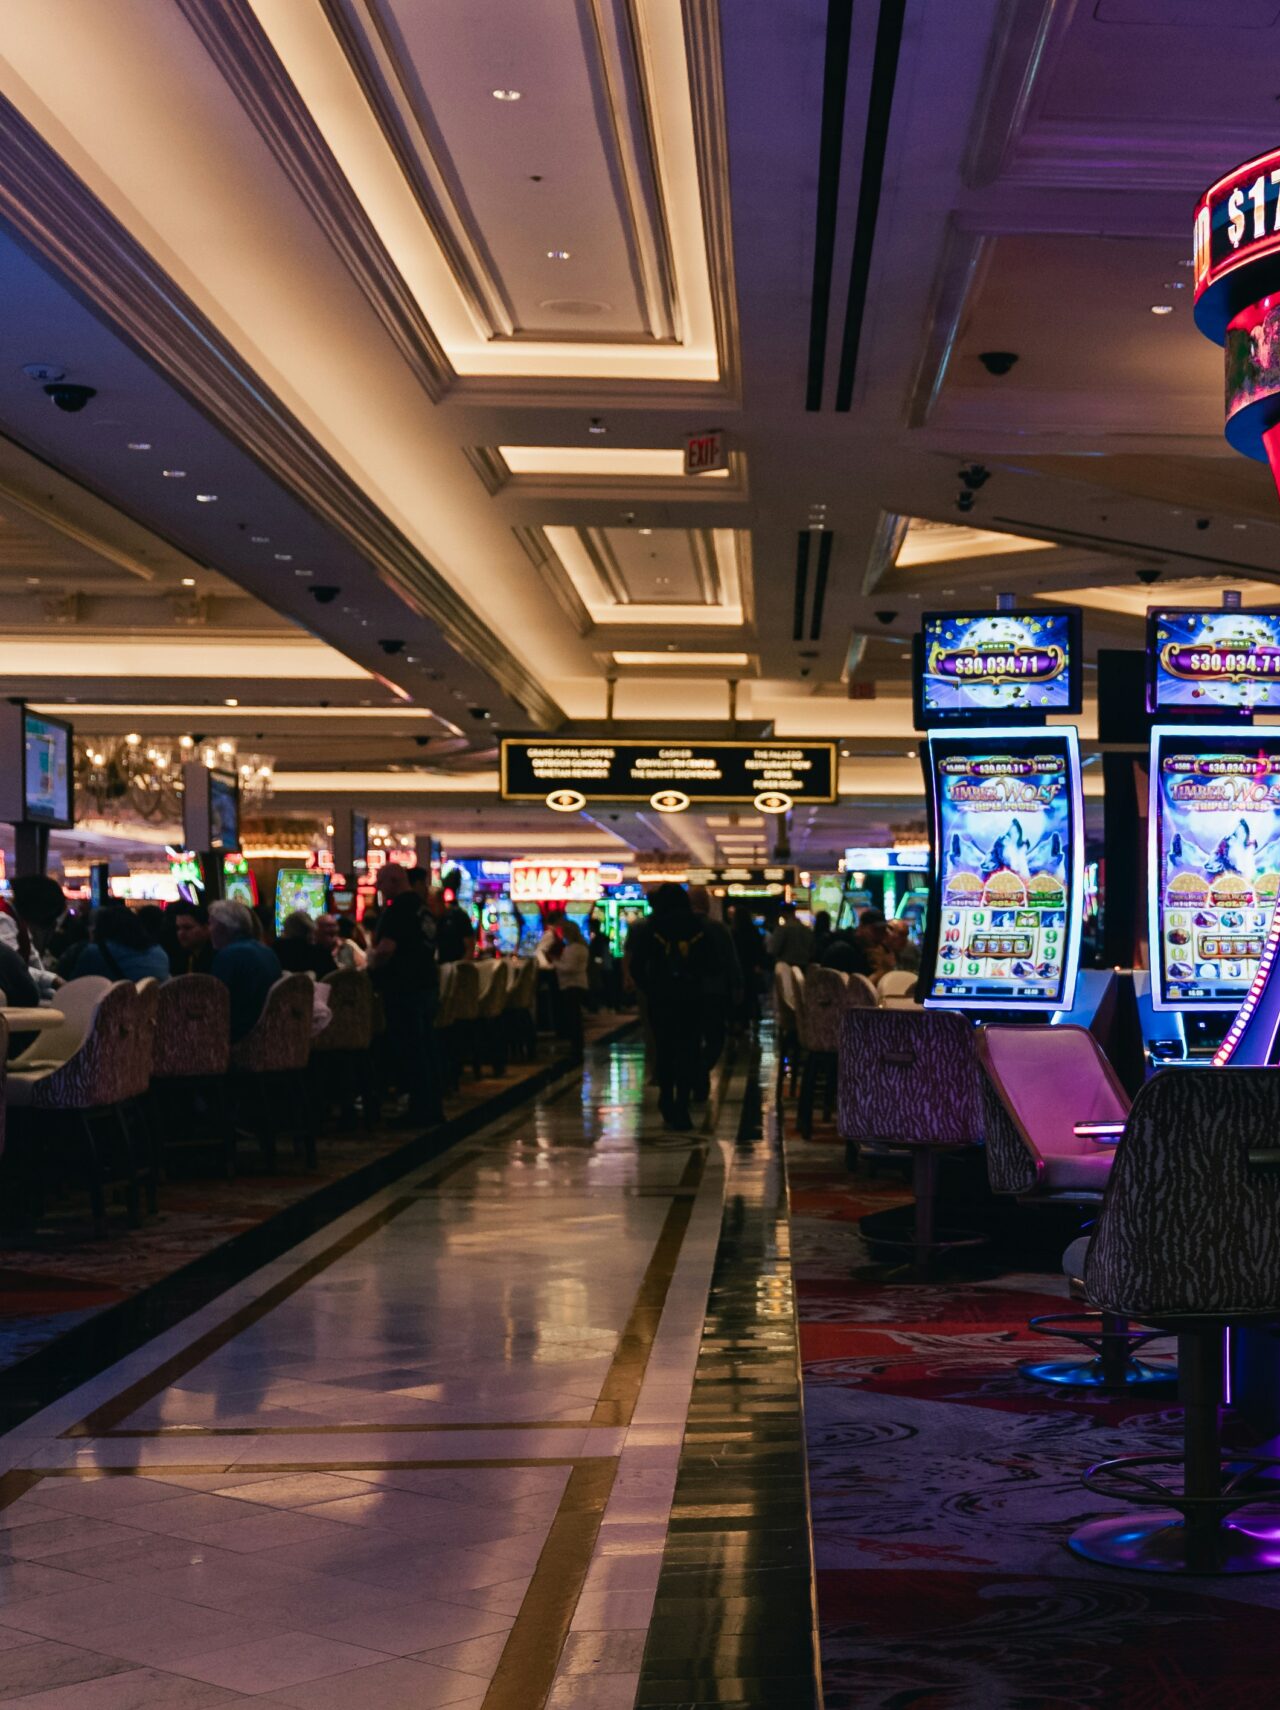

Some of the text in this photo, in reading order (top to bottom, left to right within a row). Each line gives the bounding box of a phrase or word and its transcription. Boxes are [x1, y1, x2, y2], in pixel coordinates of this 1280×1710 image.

[955, 656, 1038, 675] $30,034.71
[949, 779, 1061, 803] TIMBER WOLF
[1170, 781, 1228, 801] TIMBER
[973, 911, 984, 926] 9
[1045, 929, 1057, 943] 9
[1044, 946, 1056, 960] 9
[943, 961, 955, 975] 9
[967, 961, 979, 975] 9
